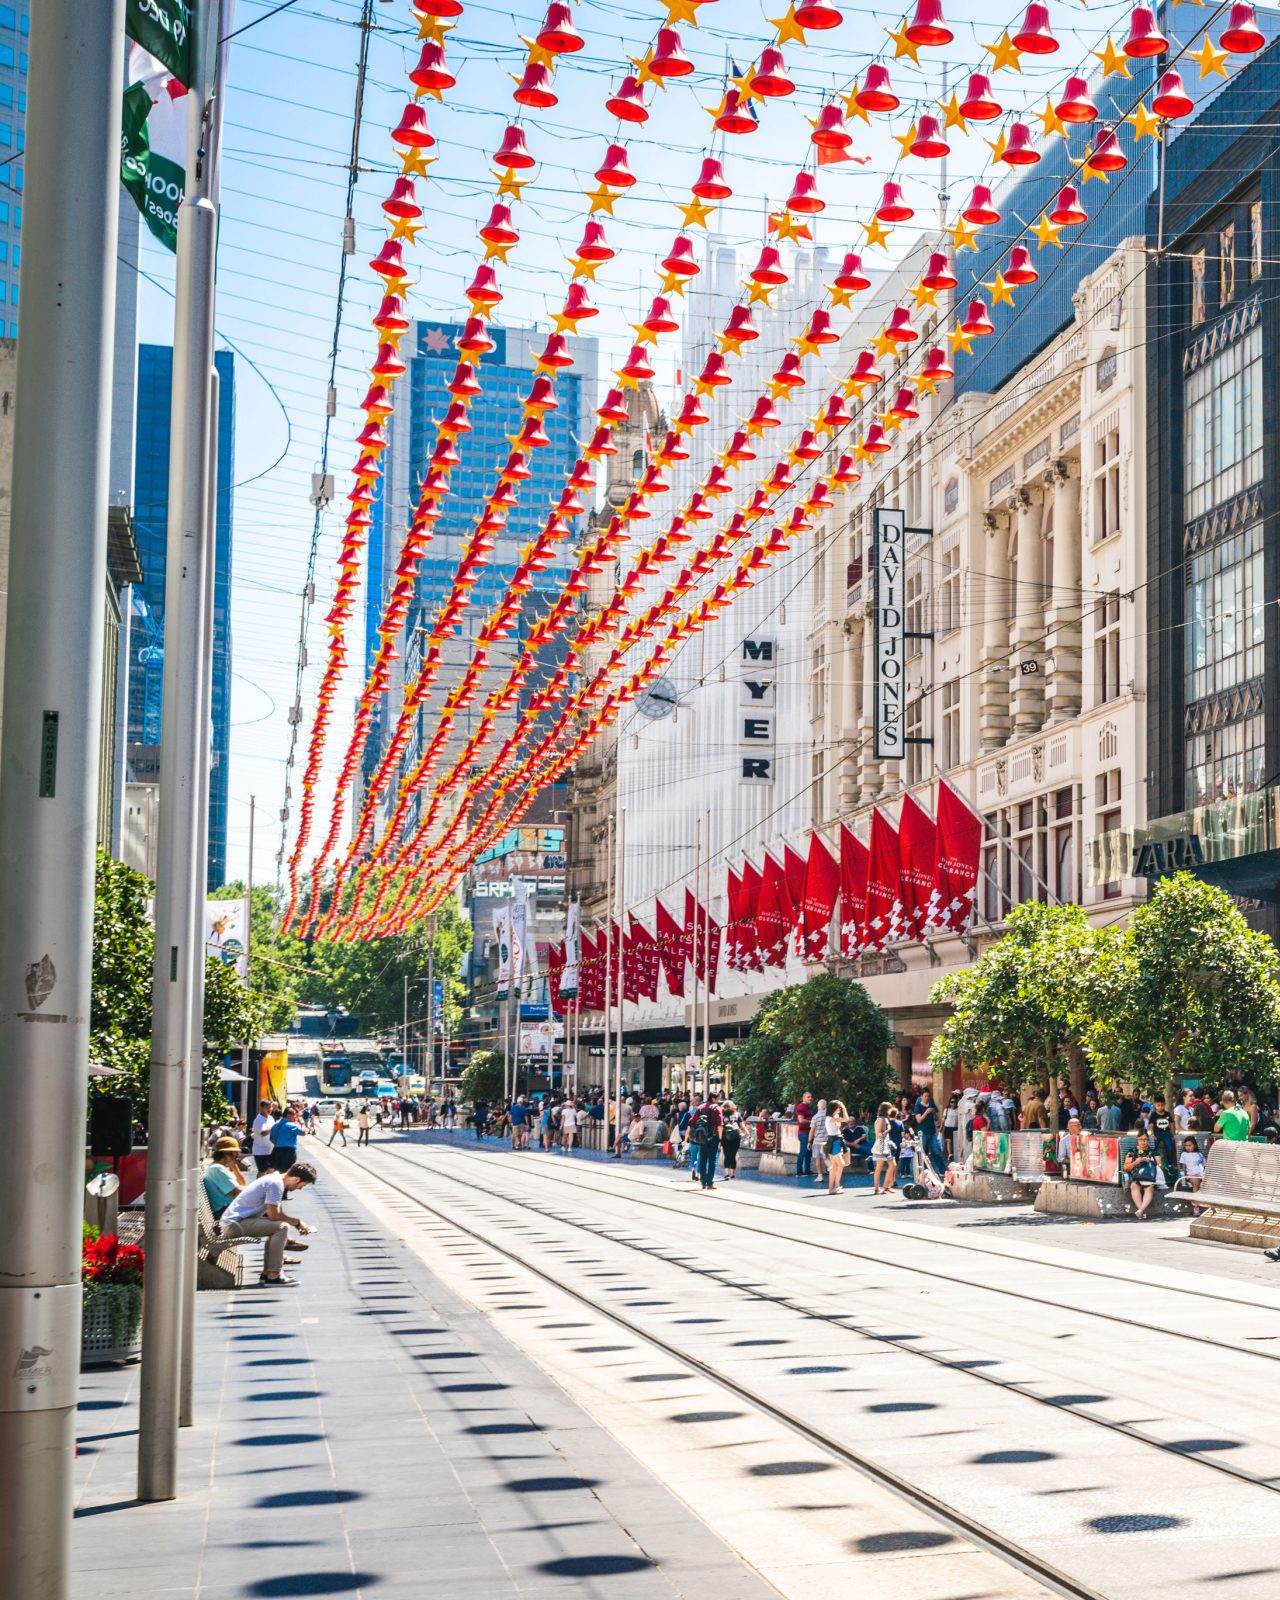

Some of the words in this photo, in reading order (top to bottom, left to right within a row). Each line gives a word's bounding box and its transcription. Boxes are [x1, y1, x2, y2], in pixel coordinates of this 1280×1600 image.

[881, 523, 901, 629] DAVID
[742, 639, 773, 779] MYER
[881, 636, 901, 747] JONES
[1022, 661, 1037, 674] 39
[1132, 834, 1205, 877] ZARA
